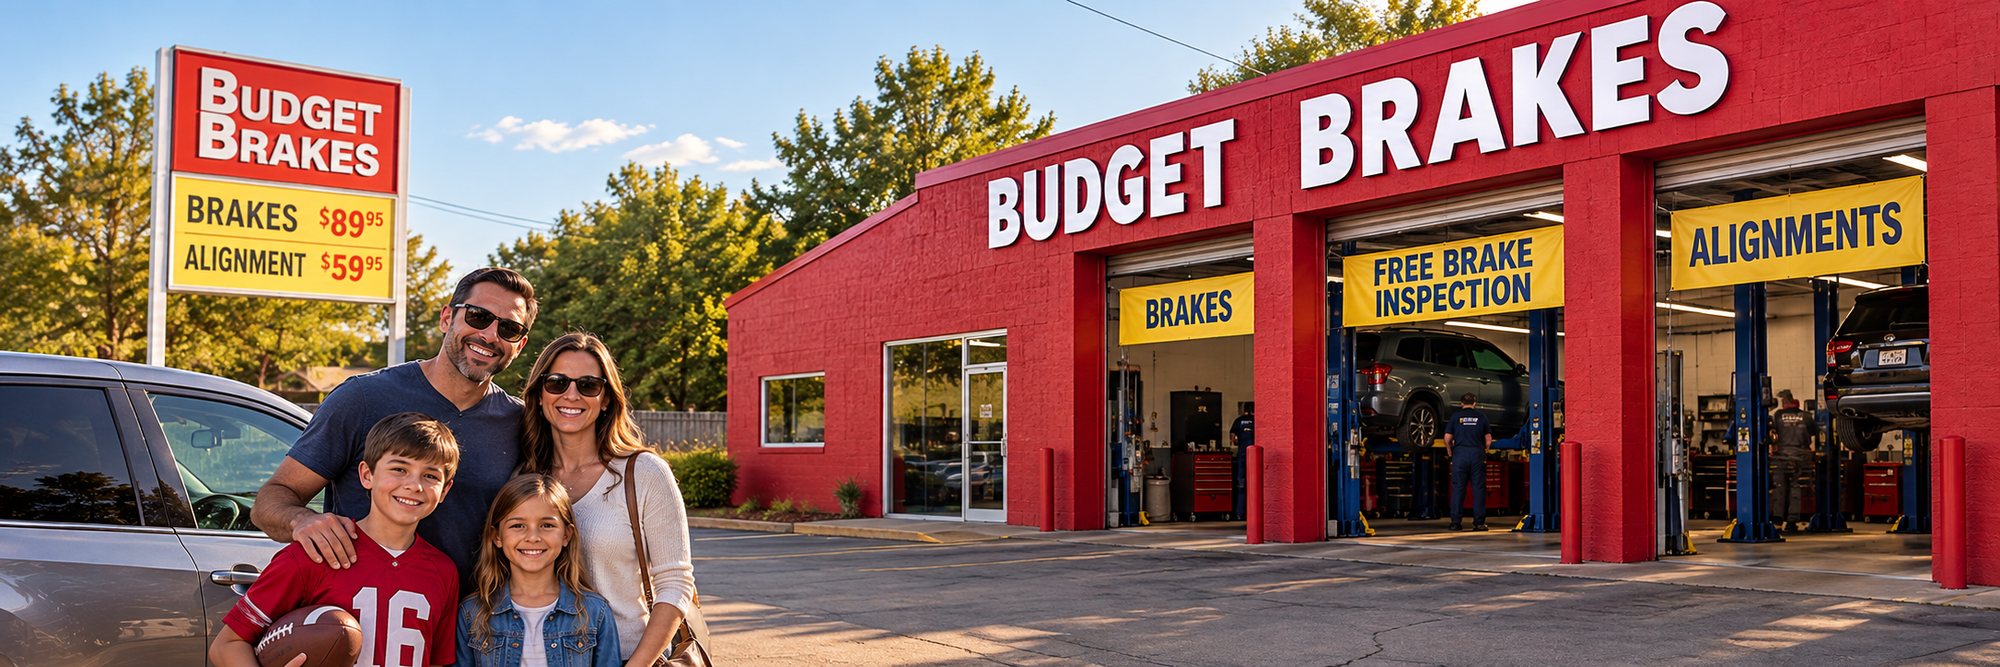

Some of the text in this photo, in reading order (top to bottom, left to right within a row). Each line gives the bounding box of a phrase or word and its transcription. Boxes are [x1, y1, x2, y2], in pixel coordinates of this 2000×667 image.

[199, 66, 382, 136] BUDGET
[988, 1, 1730, 249] BUDGET BRAKES
[198, 111, 380, 177] BRAKES
[187, 194, 298, 232] BRAKES
[1689, 201, 1902, 267] ALIGNMENTS
[184, 244, 306, 277] ALIGNMENT
[1374, 237, 1534, 287] FREE BRAKE
[1146, 289, 1233, 329] BRAKES
[1375, 272, 1532, 318] INSPECTION
[352, 586, 431, 667] 16
